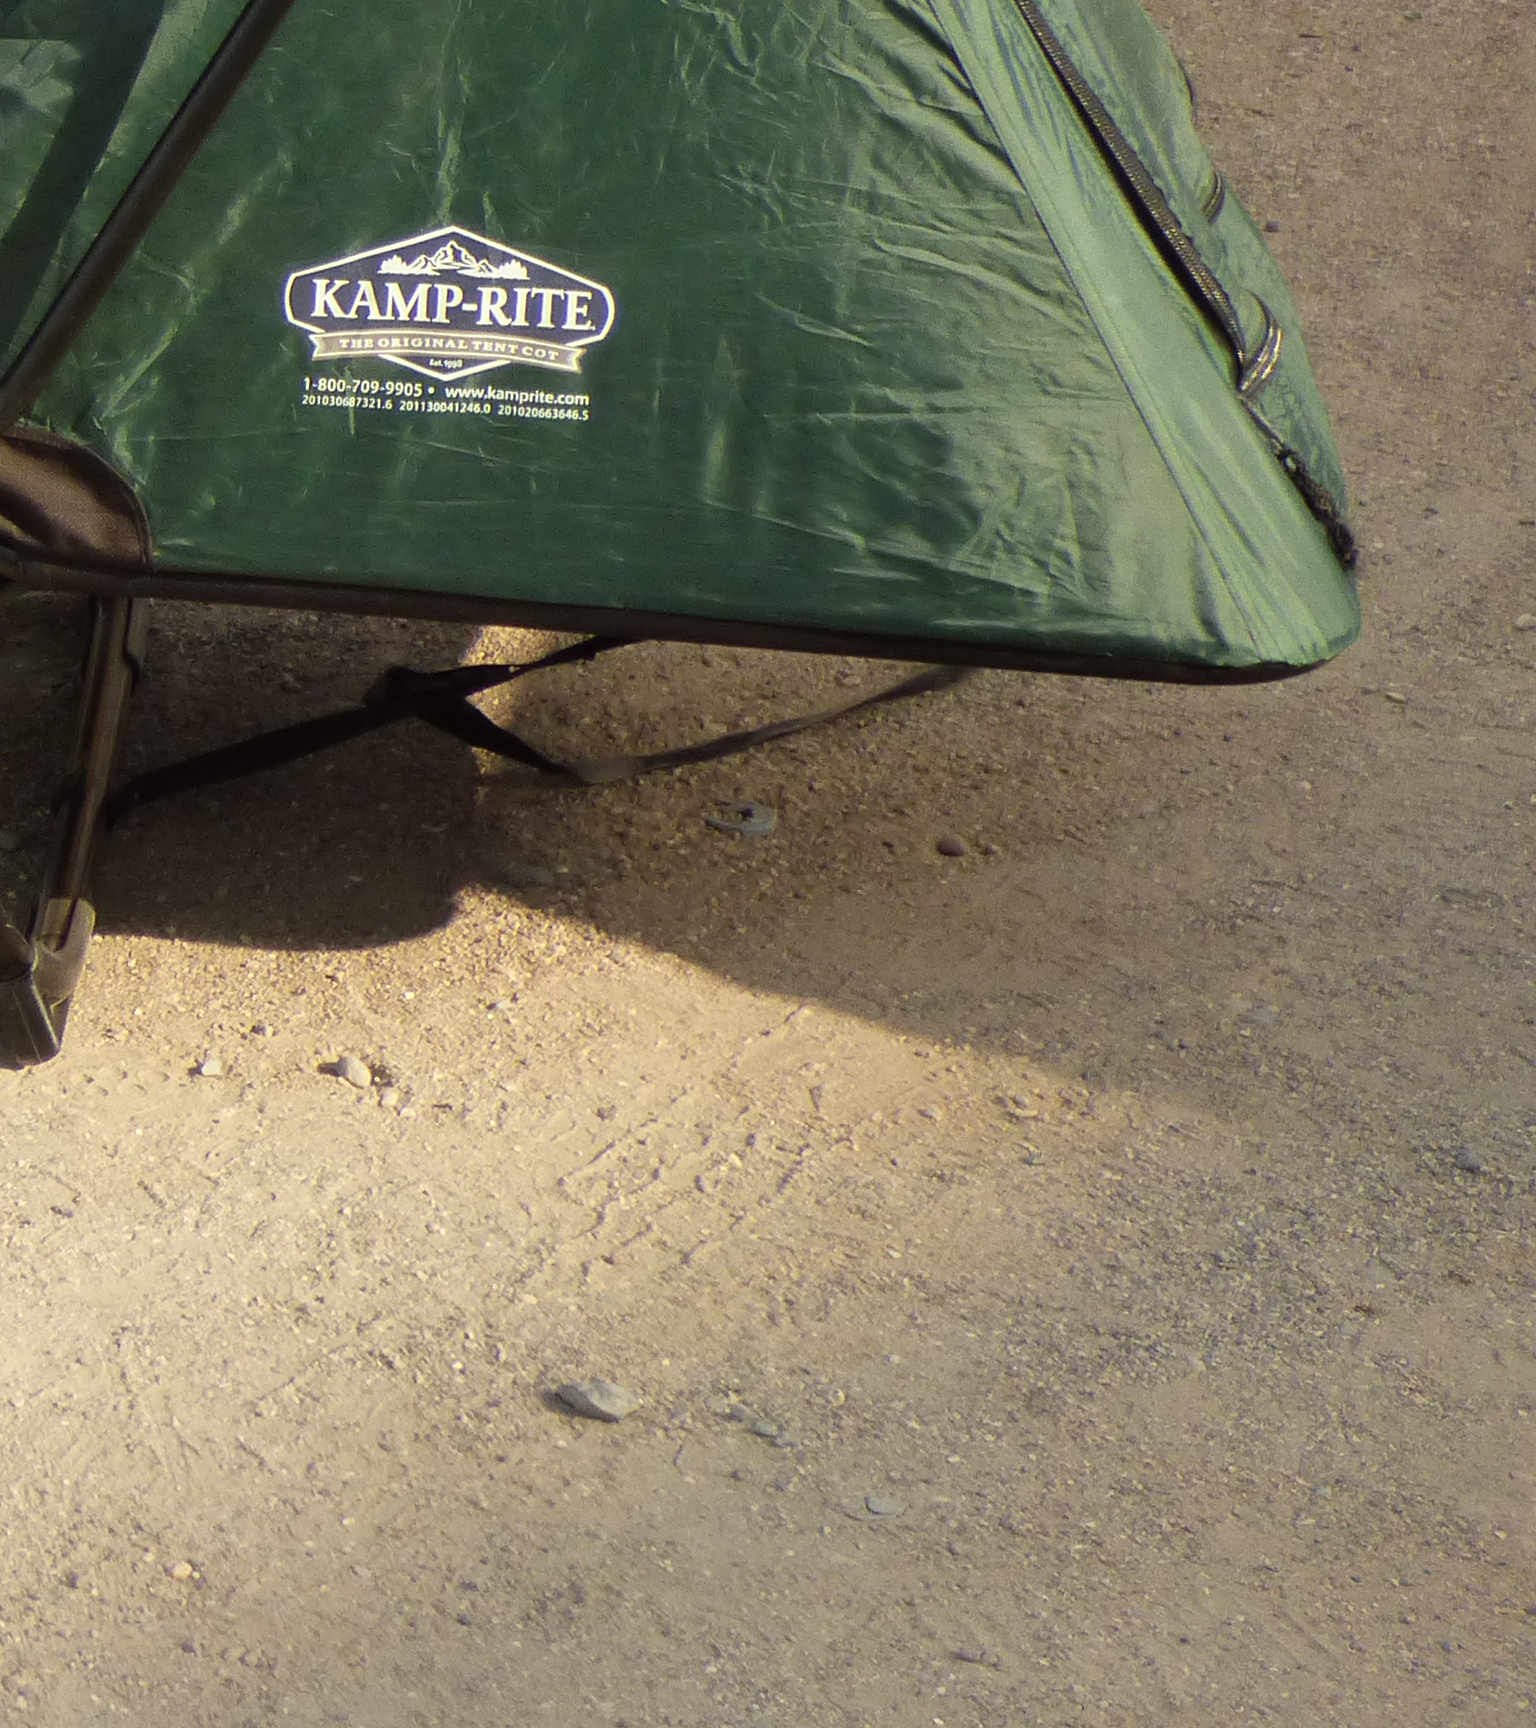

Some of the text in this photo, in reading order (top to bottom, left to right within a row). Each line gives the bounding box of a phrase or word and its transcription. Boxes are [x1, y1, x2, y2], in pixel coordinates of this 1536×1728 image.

[310, 278, 596, 332] KAMP-RITE
[339, 336, 559, 361] THE ORIGINAL TENT COT
[303, 376, 590, 406] 1-800-709-9905 www.kamprite.com
